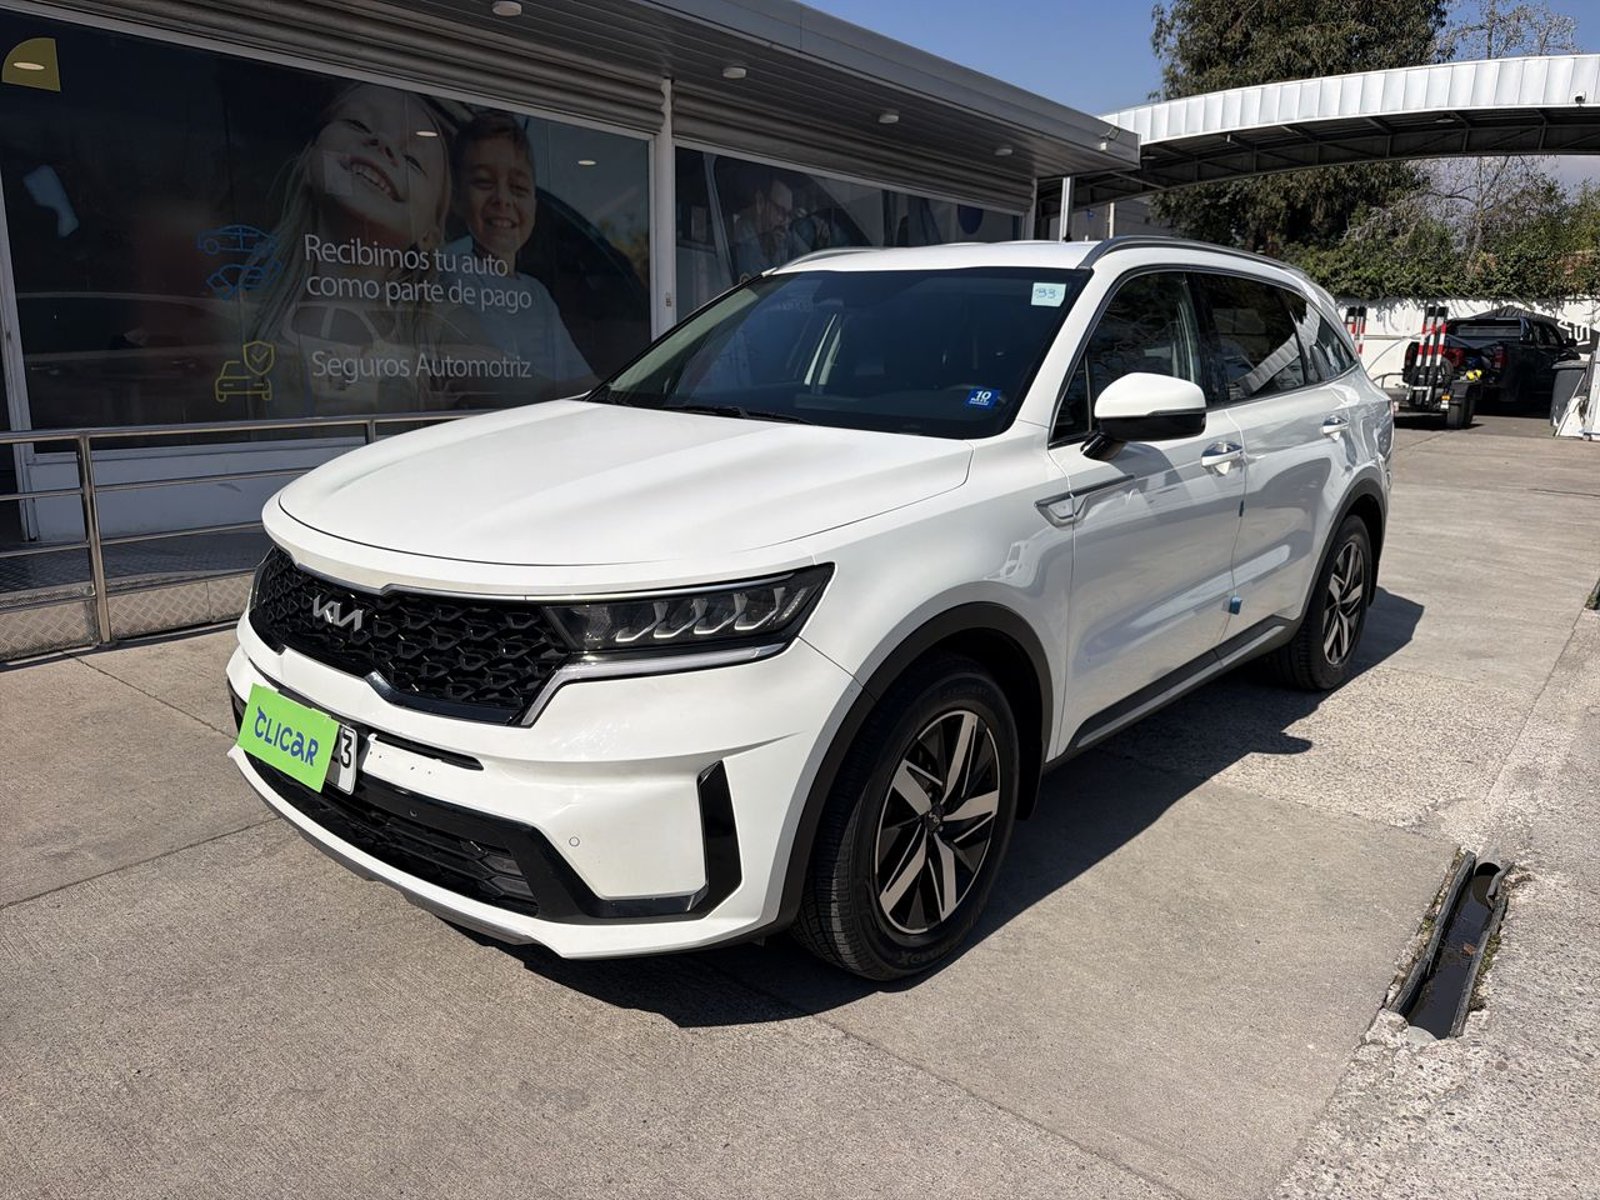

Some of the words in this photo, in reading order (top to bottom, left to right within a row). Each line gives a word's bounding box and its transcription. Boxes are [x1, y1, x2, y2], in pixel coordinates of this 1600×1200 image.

[304, 234, 430, 271] Recibimos
[434, 247, 457, 271] tu
[462, 252, 508, 277] auto
[307, 275, 380, 300] como
[385, 279, 444, 306] parte
[449, 279, 476, 303] de
[481, 287, 532, 314] pago
[312, 351, 410, 384] Seguros
[415, 352, 532, 379] Automotriz
[975, 390, 992, 401] 10
